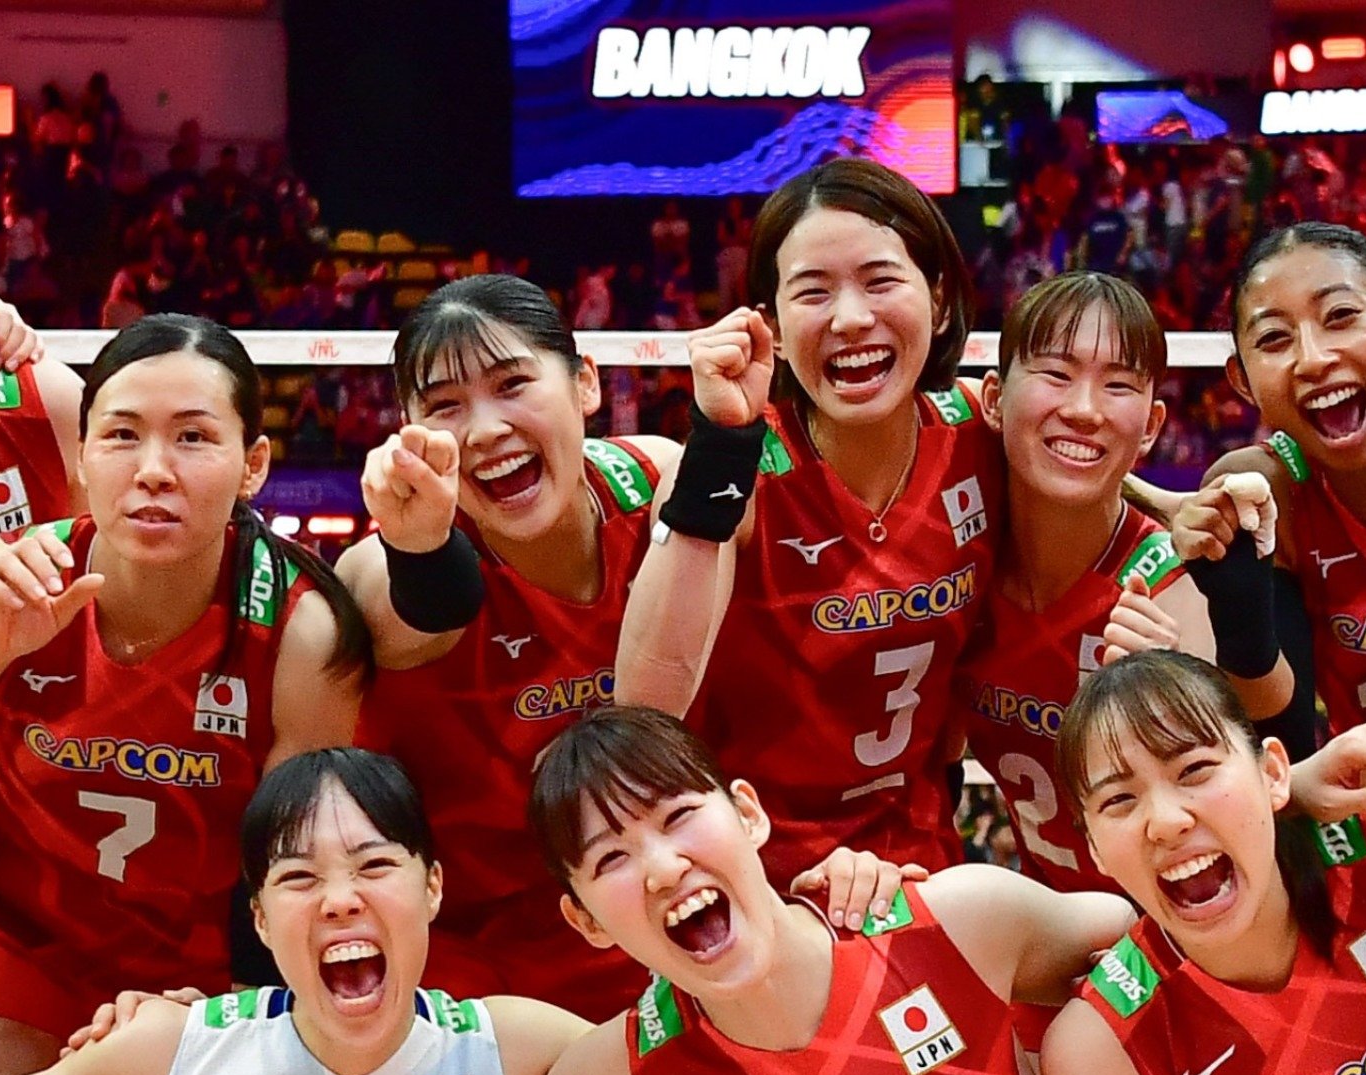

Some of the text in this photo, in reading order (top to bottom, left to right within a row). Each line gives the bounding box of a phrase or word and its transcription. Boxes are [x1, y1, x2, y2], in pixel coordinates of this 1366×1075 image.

[593, 27, 870, 97] BANGKOK
[958, 514, 985, 545] JPN
[812, 562, 977, 634] CAPCOM
[202, 713, 240, 734] JPN
[514, 668, 615, 720] CAPC
[854, 642, 935, 767] 3
[24, 723, 220, 787] CAPCOM
[78, 791, 156, 882] 7
[915, 1035, 955, 1069] JPN
